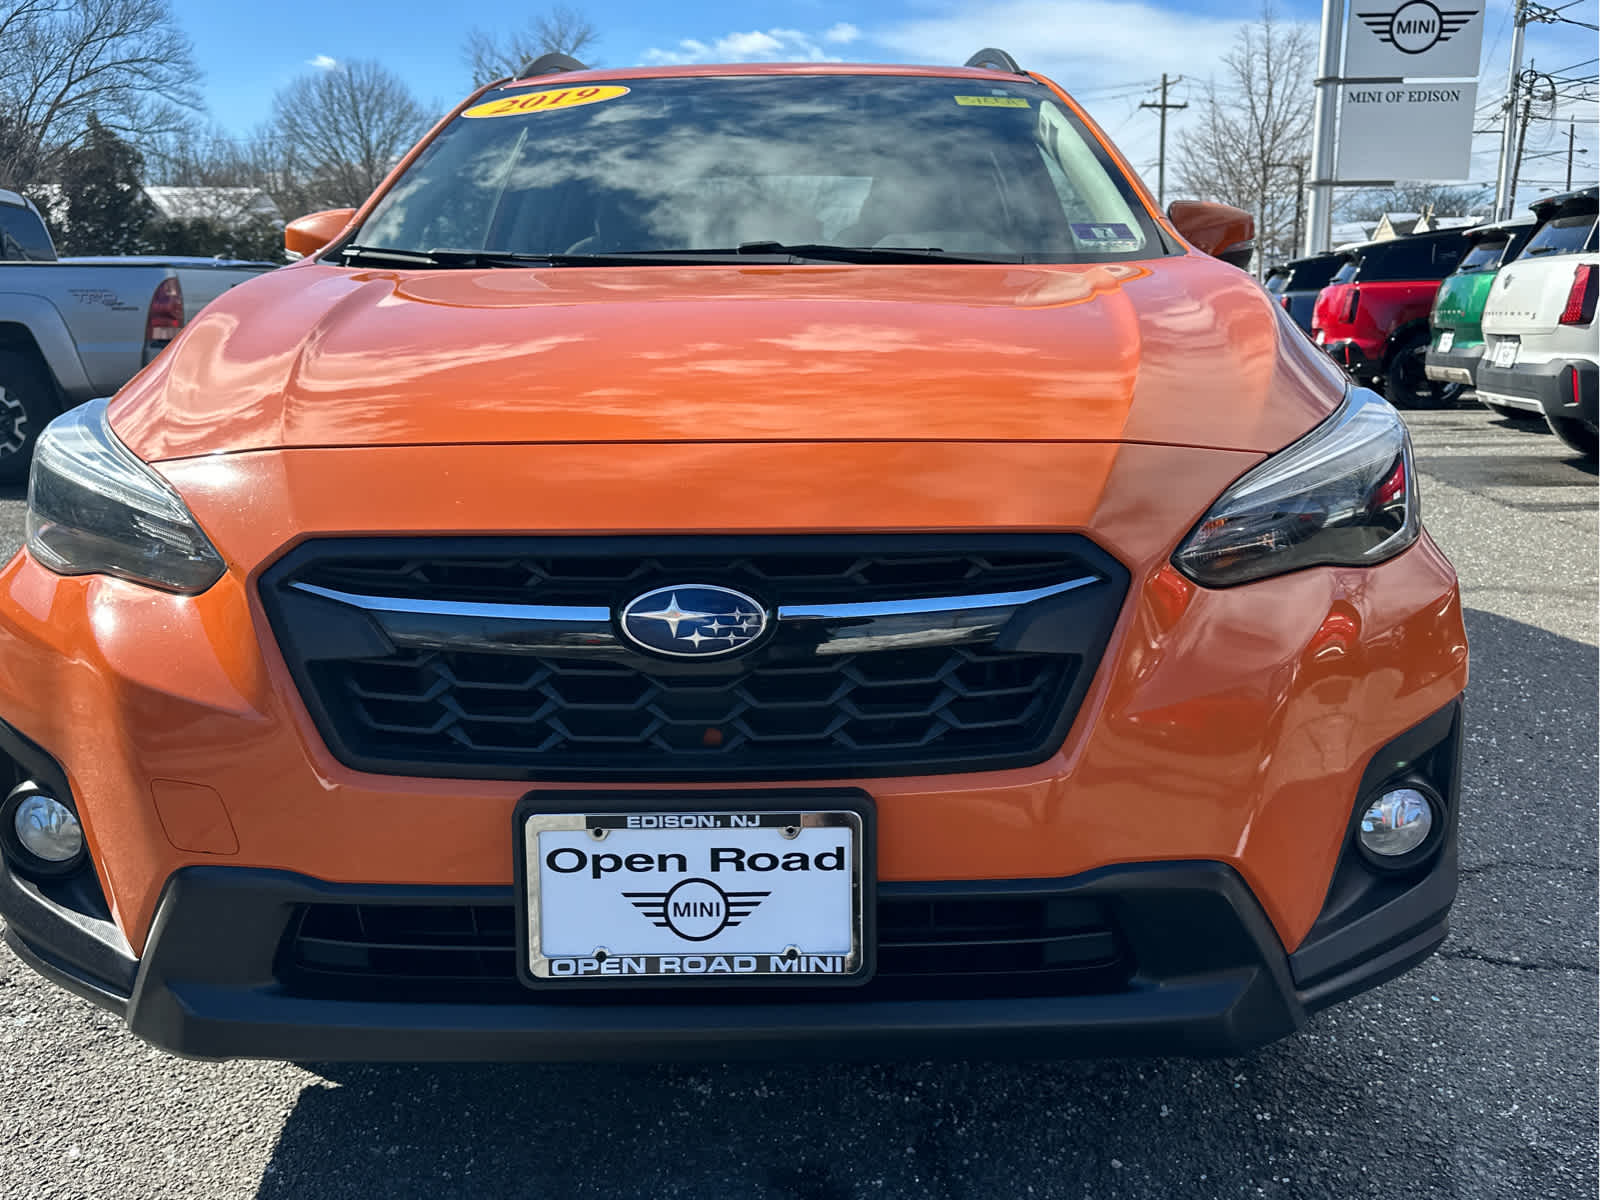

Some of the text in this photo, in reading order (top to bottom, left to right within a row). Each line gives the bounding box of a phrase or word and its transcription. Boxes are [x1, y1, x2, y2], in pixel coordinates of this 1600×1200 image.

[1396, 19, 1436, 35] MINI
[491, 88, 600, 115] 2019
[1348, 90, 1461, 103] MINI OF EDISON
[626, 814, 761, 829] EDISON, NJ
[545, 846, 846, 879] Open Road
[673, 901, 721, 918] MINI
[551, 956, 845, 975] OPEN ROAD MINI
